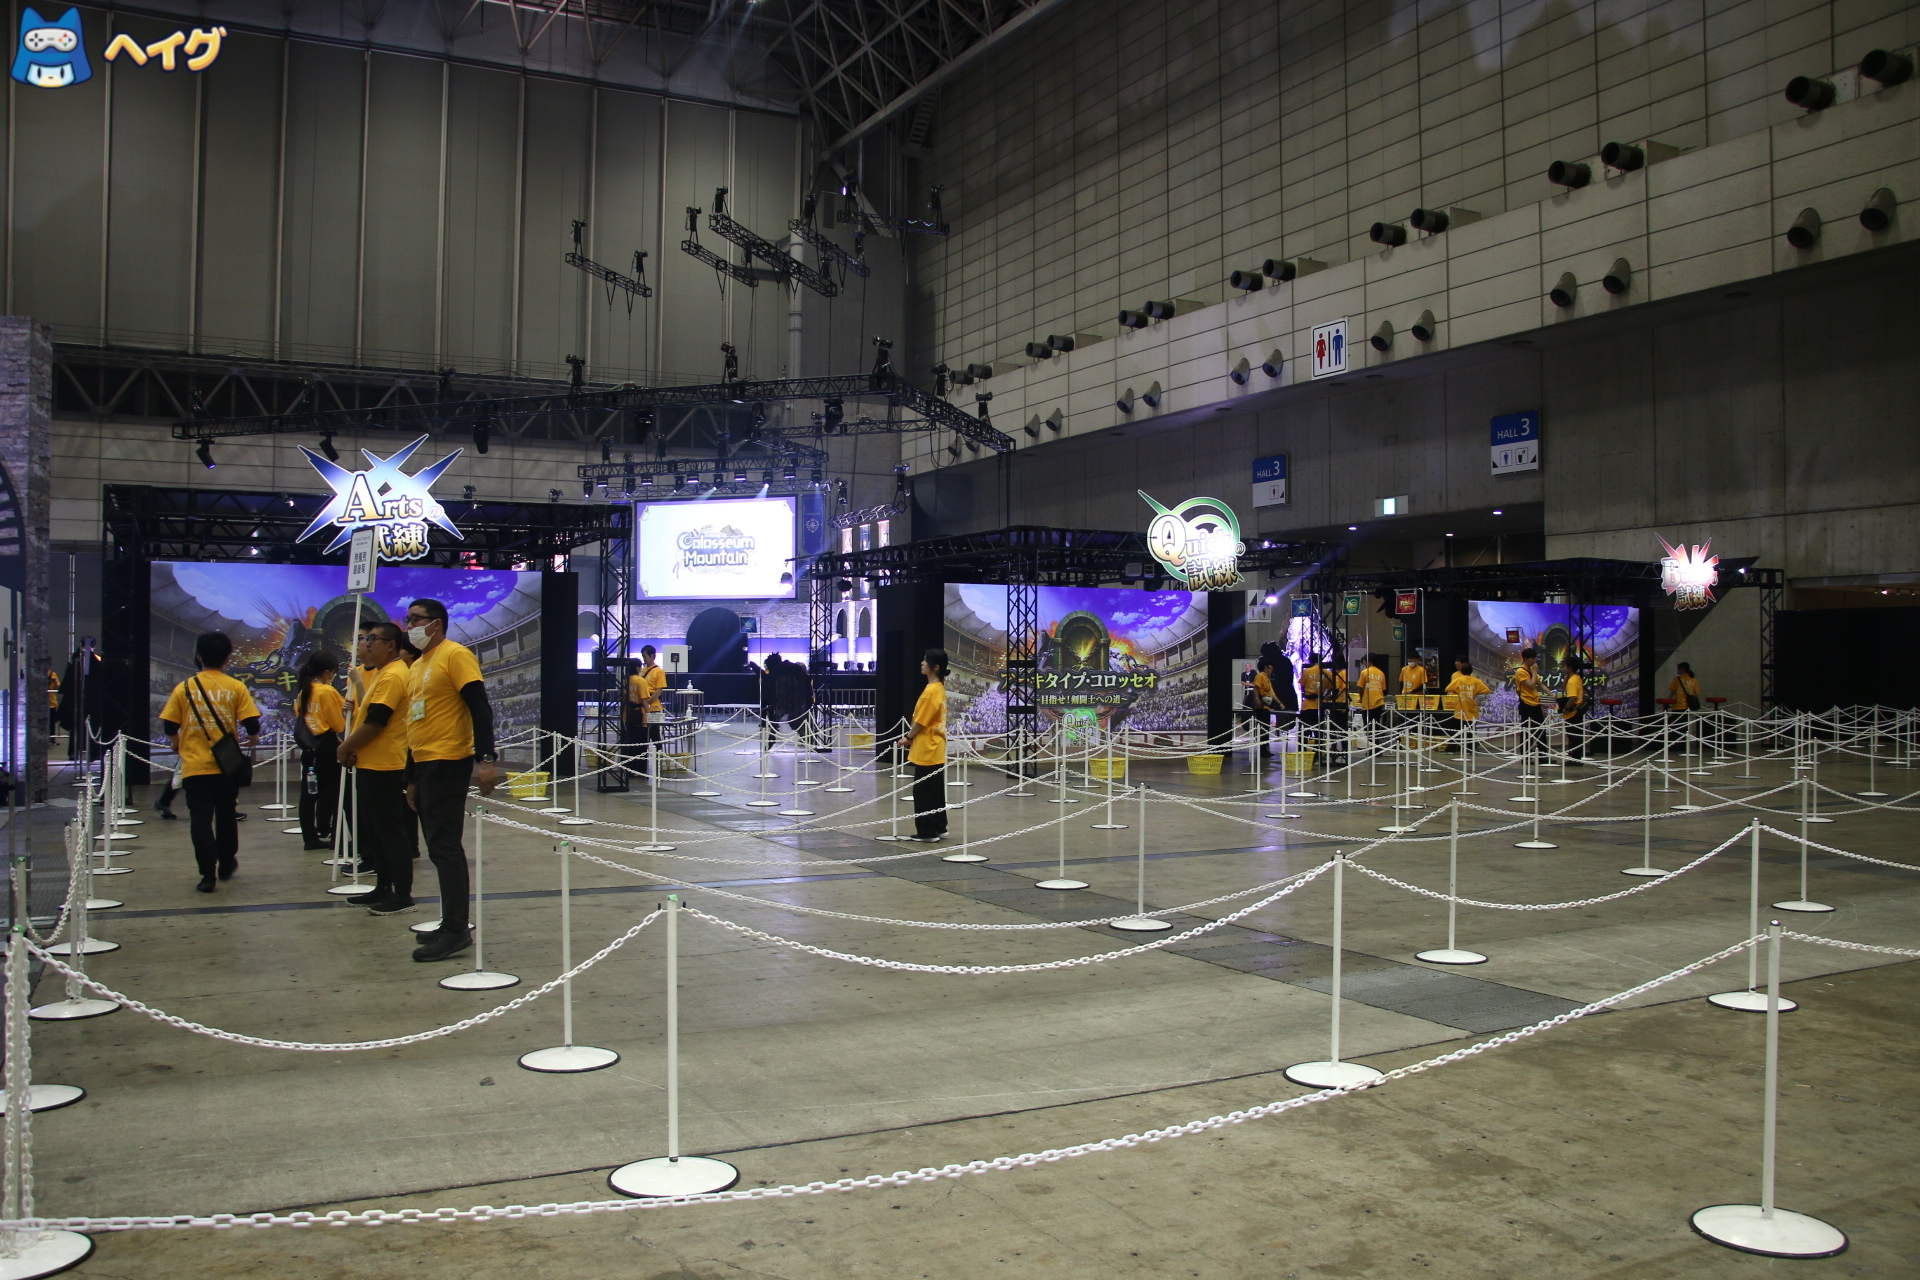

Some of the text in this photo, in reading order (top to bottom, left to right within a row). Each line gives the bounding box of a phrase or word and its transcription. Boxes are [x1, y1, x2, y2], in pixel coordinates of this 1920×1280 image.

[1497, 418, 1530, 439] HALL 3
[1257, 461, 1280, 478] HALL 3
[684, 550, 748, 568] Mountain
[1187, 558, 1238, 589] 試練
[1677, 585, 1707, 609] 試練
